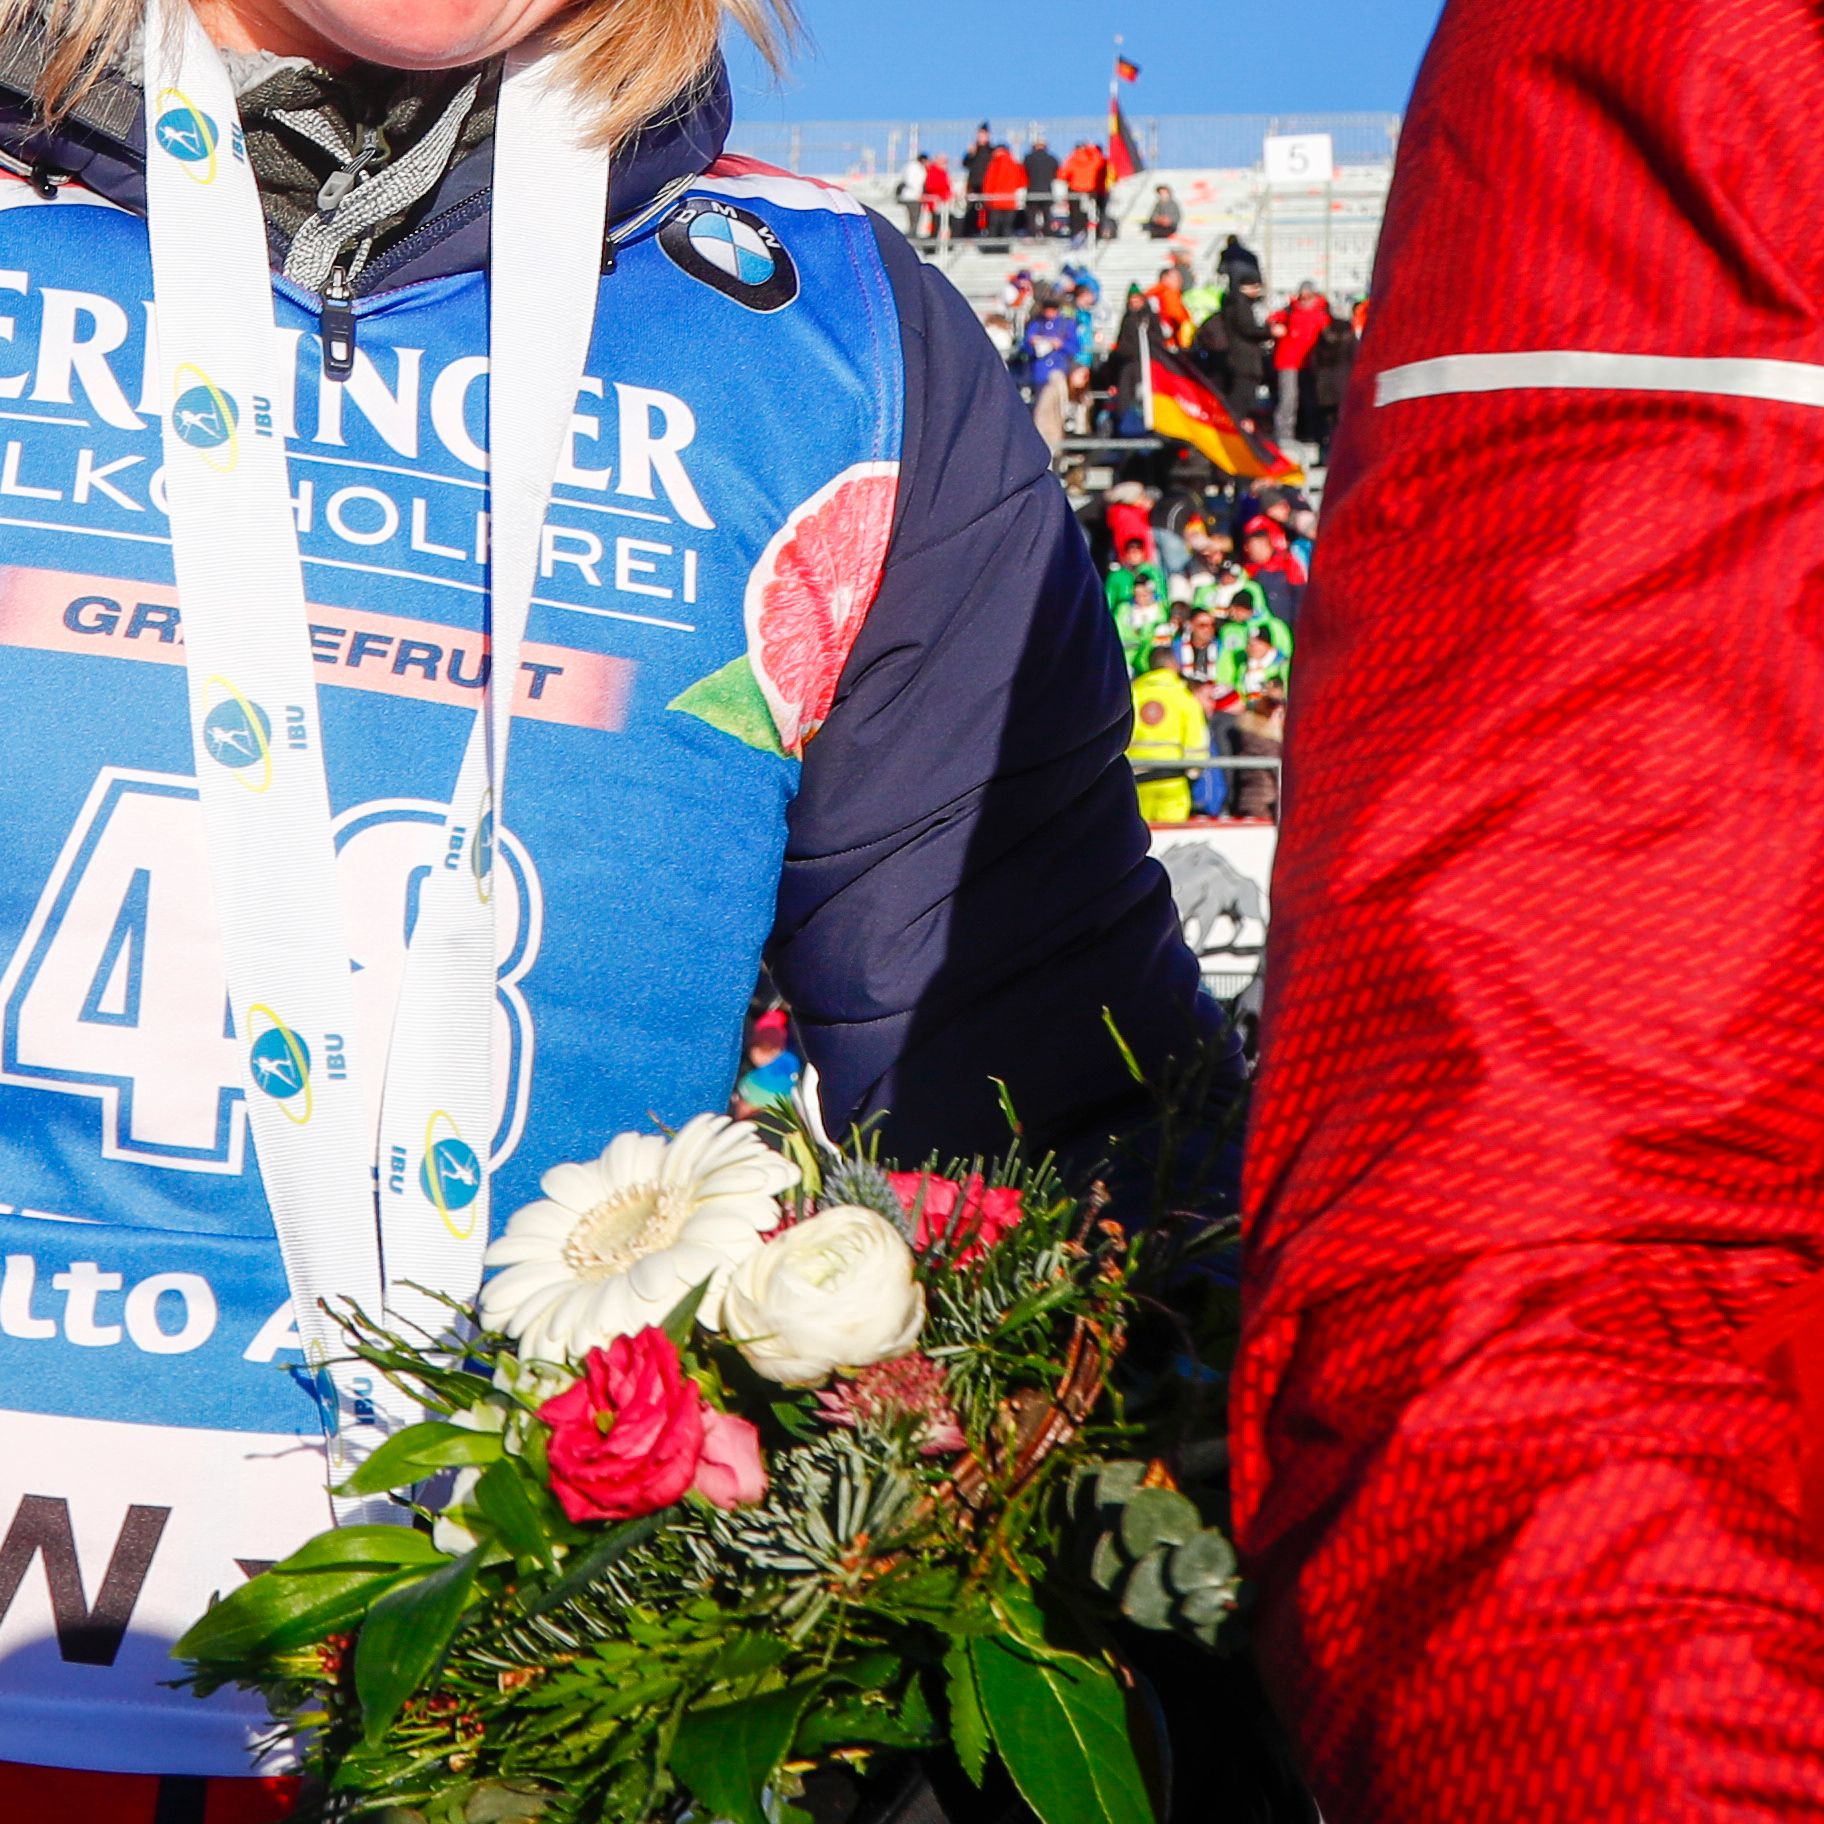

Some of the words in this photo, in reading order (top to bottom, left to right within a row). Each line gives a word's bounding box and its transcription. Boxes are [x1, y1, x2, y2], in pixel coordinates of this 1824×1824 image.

[1287, 143, 1309, 175] 5
[253, 394, 274, 439] IBU
[285, 703, 308, 751] IBU
[443, 825, 467, 871] IBU
[325, 1032, 348, 1081] IBU
[388, 1144, 408, 1196] IBU
[353, 1376, 375, 1426] IBU
